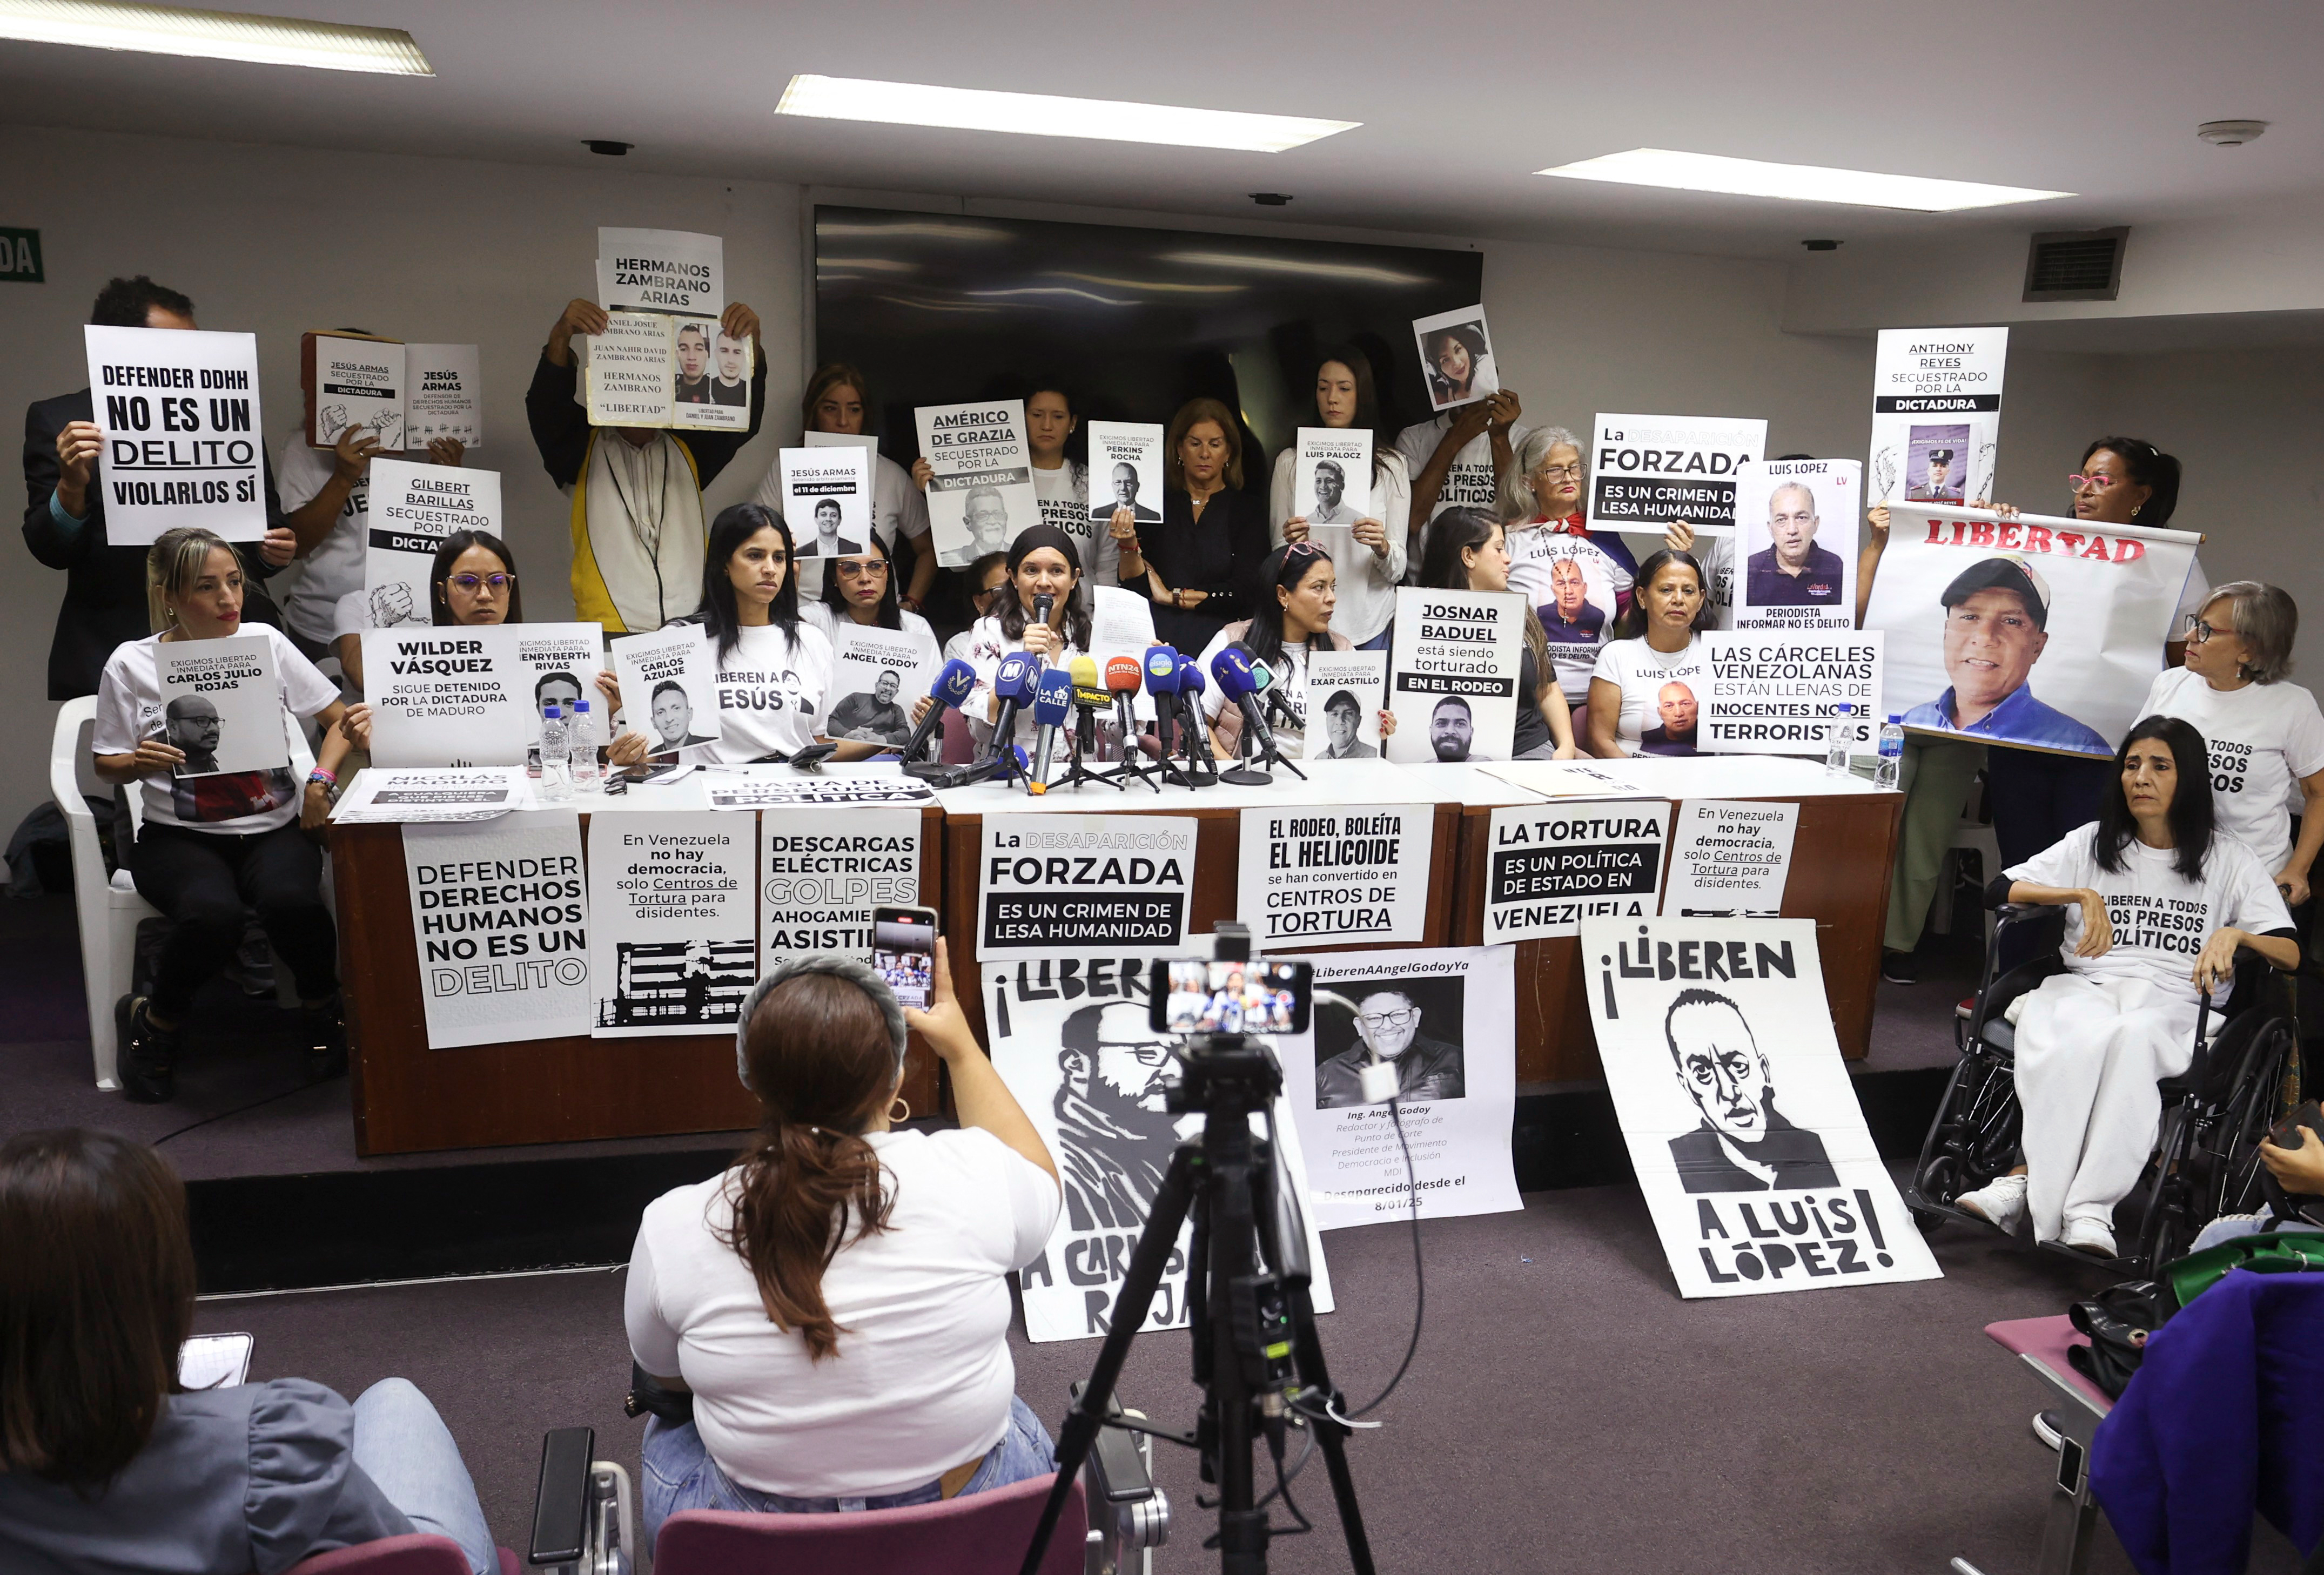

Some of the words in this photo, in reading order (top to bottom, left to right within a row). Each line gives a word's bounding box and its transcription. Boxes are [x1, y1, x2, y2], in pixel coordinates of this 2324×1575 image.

[616, 258, 710, 277] HERMANOS
[616, 273, 710, 293] ZAMBRANO
[640, 291, 689, 305] ARIAS
[1910, 344, 1974, 353] ANTHONY
[331, 361, 357, 370] JESÚS
[359, 365, 388, 373] ARMAS
[1920, 358, 1960, 367] REYES
[102, 365, 194, 389] DEFENDER
[200, 369, 248, 389] DDHH
[331, 371, 389, 381] SECUESTRADO
[424, 370, 458, 380] JESÚS
[604, 372, 661, 382] HERMANOS
[1892, 372, 1987, 382] SECUESTRADO
[338, 387, 382, 396] DICTADURA
[604, 383, 661, 393] ZAMBRANO
[1916, 384, 1941, 393] POR
[1896, 399, 1976, 410] DICTADURA
[106, 396, 150, 432] NO
[163, 398, 200, 432] ES
[209, 399, 251, 432] UN
[933, 410, 1009, 427] AMÉRICO
[957, 429, 1015, 443] GRAZIA
[112, 440, 254, 465] DELITO
[935, 446, 1018, 461] SECUESTRADO
[958, 460, 981, 469] POR
[1770, 464, 1791, 475] LUIS
[1796, 463, 1828, 474] LOPEZ
[791, 468, 820, 476] JESÚS
[412, 479, 470, 493] GILBERT
[944, 473, 1015, 488] DICTADURA
[113, 481, 229, 505] VIOLARLOS
[237, 475, 255, 502] SÍ
[406, 494, 473, 509] BARILLAS
[386, 507, 489, 526] SECUESTRADO
[414, 522, 443, 534] POR
[1924, 519, 2145, 563] LIBERTAD
[1422, 604, 1497, 620] JOSNAR
[1766, 608, 1820, 617] PERIODISTA
[1737, 620, 1785, 629] INFORMAR
[1818, 618, 1849, 628] DELITO
[1421, 625, 1496, 641] BADUEL
[398, 641, 482, 656] WILDER
[626, 649, 660, 660] EXIGIMOS
[662, 642, 695, 653] LIBERTAD
[1418, 645, 1444, 656] está
[1449, 647, 1494, 658] siendo
[1711, 647, 1751, 662] LAS
[1759, 643, 1875, 662] CÁRCELES
[171, 658, 213, 667] EXIGIMOS
[216, 655, 257, 664] LIBERTAD
[631, 655, 669, 665] INMEDIATA
[672, 649, 691, 658] PARA
[843, 652, 878, 663] ANGEL
[881, 657, 918, 669] GODOY
[177, 664, 225, 673] INMEDIATA
[391, 659, 492, 676] VÁSQUEZ
[535, 662, 570, 670] RIVAS
[641, 658, 684, 672] CARLOS
[1109, 664, 1139, 672] NTN24
[1415, 658, 1497, 674] torturado
[1713, 664, 1871, 679] VENEZOLANAS
[166, 672, 221, 684] CARLOS
[224, 668, 262, 678] JULIO
[643, 667, 685, 682] AZUAJE
[770, 672, 779, 682] A
[1636, 669, 1664, 678] LUIS
[195, 681, 238, 691] ROJAS
[393, 684, 430, 694] SIGUE
[434, 682, 500, 692] DETENIDO
[1452, 681, 1503, 694] RODEO
[1715, 681, 1769, 696] ESTÁN
[1777, 684, 1842, 696] LLENAS
[382, 697, 408, 706] POR
[432, 694, 507, 704] DICTADURA
[1039, 697, 1067, 706] CALLE
[428, 706, 485, 716] MADURO
[1711, 703, 1810, 716] INOCENTES
[2211, 739, 2253, 755] TODOS
[1270, 820, 1284, 838] EL
[1289, 818, 1339, 838] RODEO,
[1345, 812, 1401, 836] BOLEÍTA
[1499, 824, 1529, 845] LA
[1535, 819, 1661, 842] TORTURA
[648, 834, 730, 846] Venezuela
[773, 837, 914, 852] DESCARGAS
[1026, 830, 1187, 850] DESAPARICIÓN
[675, 849, 703, 862] hay
[1270, 842, 1291, 869] EL
[1299, 839, 1399, 867] HELICOIDE
[1561, 850, 1642, 870] POLÍTICA
[628, 864, 726, 876] democracia,
[772, 854, 912, 873] ELÉCTRICAS
[417, 857, 577, 885] DEFENDER
[990, 857, 1184, 885] FORZADA
[1286, 873, 1308, 884] han
[1313, 870, 1378, 882] convertido
[617, 878, 648, 890] solo
[653, 878, 713, 889] Centros
[1531, 875, 1602, 891] ESTADO
[420, 880, 581, 909] DERECHOS
[765, 877, 916, 904] GOLPES
[1267, 887, 1362, 907] CENTROS
[629, 892, 686, 904] Tortura
[691, 893, 725, 905] para
[636, 907, 720, 918] disidentes.
[1063, 904, 1139, 918] CRIMEN
[2155, 898, 2164, 908] A
[2168, 899, 2207, 915] TODOS
[422, 904, 582, 934] HUMANOS
[1267, 908, 1392, 933] TORTURA
[2136, 910, 2204, 933] PRESOS
[995, 924, 1043, 939] LESA
[1049, 924, 1172, 938] HUMANIDAD
[426, 938, 477, 962] NO
[487, 934, 529, 957] ES
[539, 929, 586, 952] UN
[432, 958, 587, 997] DELITO
[1399, 1106, 1430, 1115] Godoy
[1336, 1122, 1378, 1132] Redactor
[1355, 1133, 1381, 1143] Punto
[1384, 1168, 1402, 1177] MDI
[1696, 1199, 1730, 1239] A
